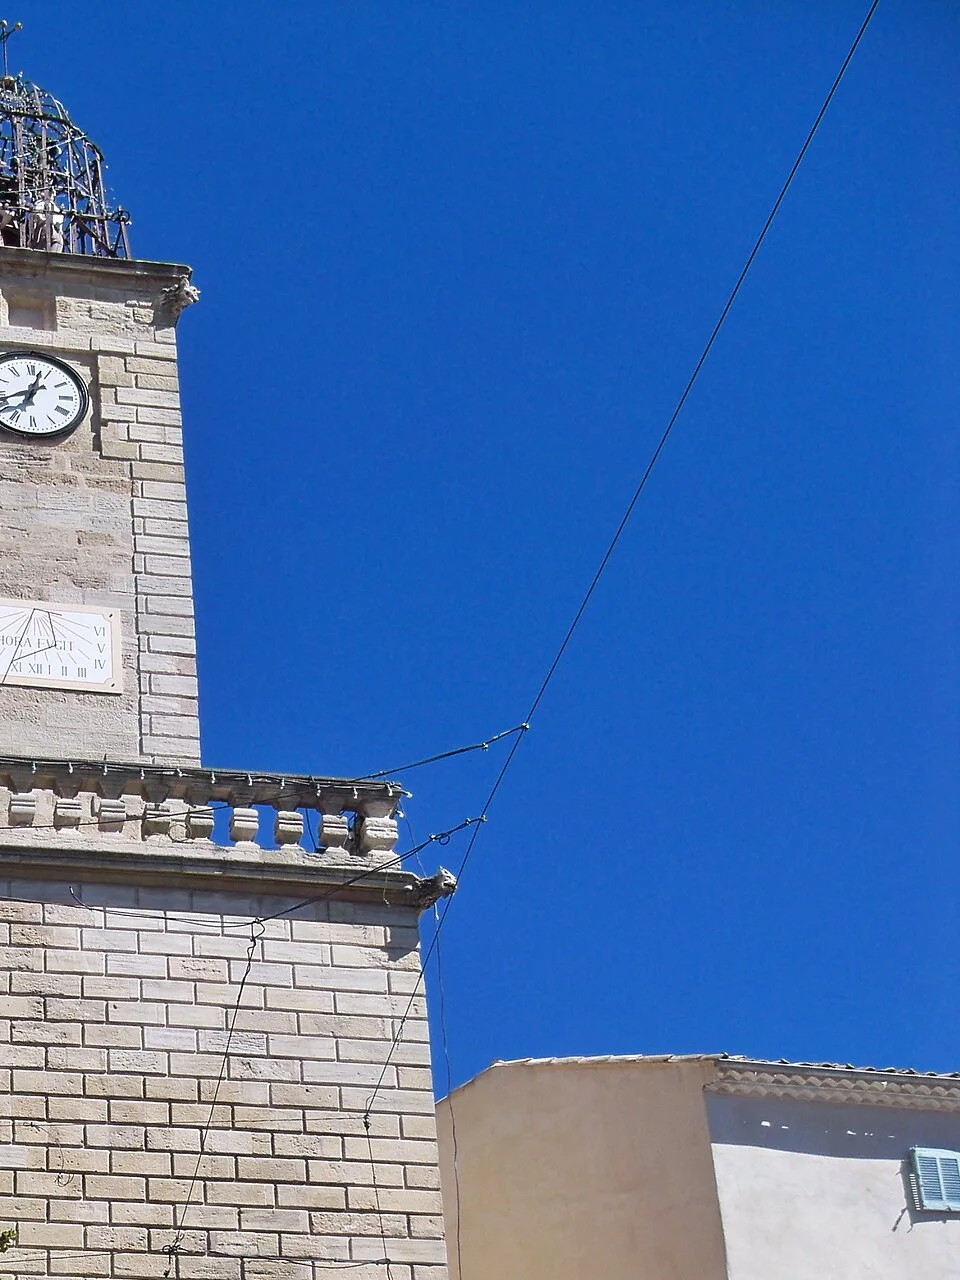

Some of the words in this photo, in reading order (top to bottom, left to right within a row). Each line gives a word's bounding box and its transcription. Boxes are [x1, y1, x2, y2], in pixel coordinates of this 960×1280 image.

[93, 626, 105, 637] VI
[96, 643, 106, 653] V
[11, 661, 22, 672] XI
[28, 663, 42, 675] XII
[94, 658, 107, 669] IV
[61, 665, 68, 676] II
[77, 667, 87, 678] III
